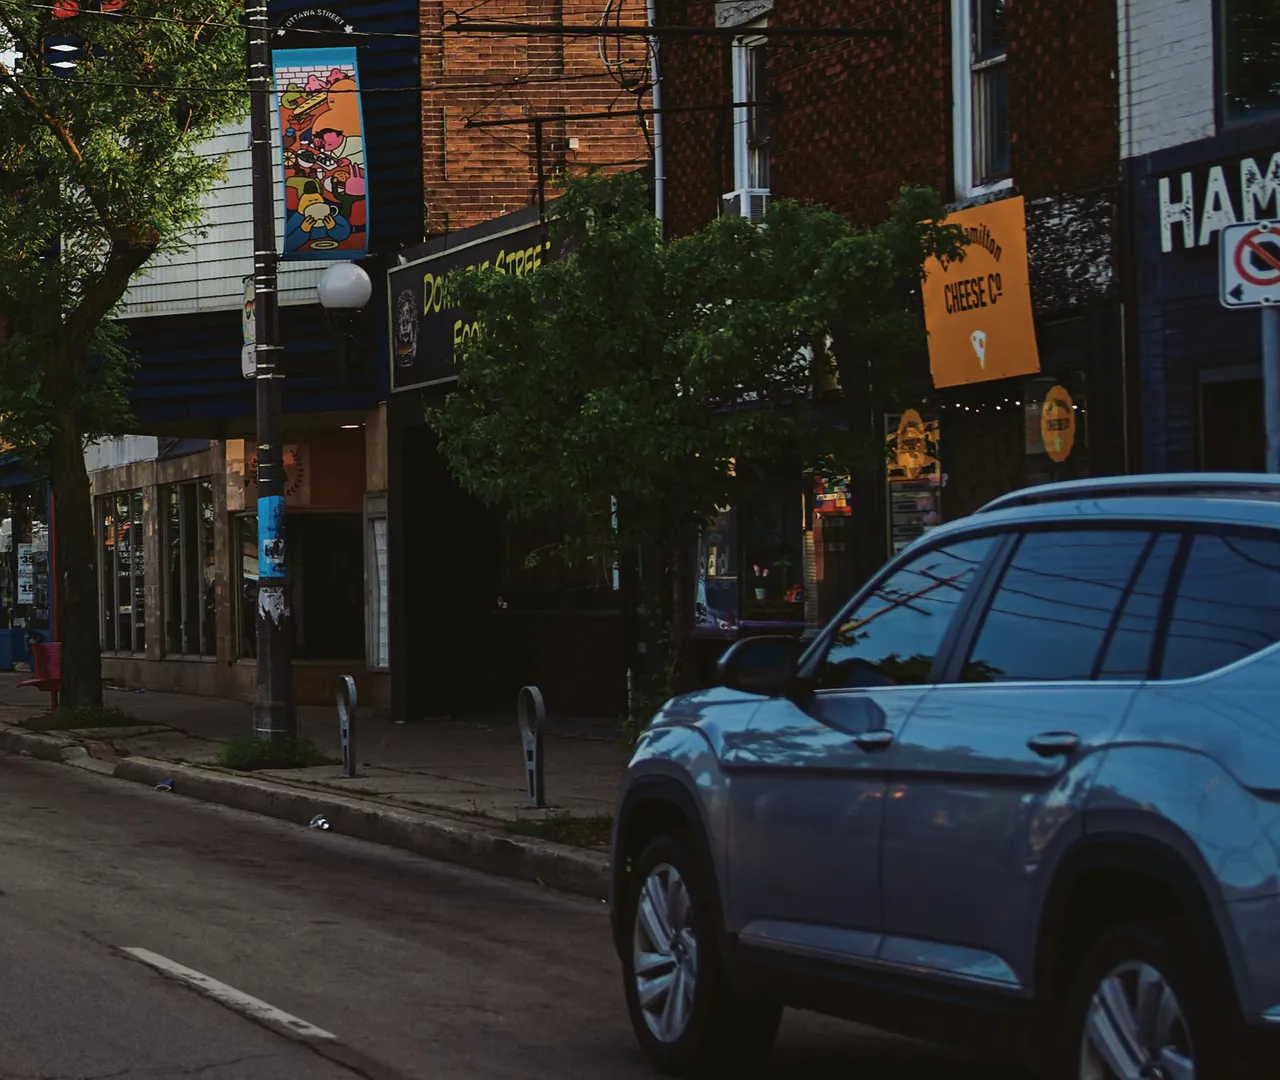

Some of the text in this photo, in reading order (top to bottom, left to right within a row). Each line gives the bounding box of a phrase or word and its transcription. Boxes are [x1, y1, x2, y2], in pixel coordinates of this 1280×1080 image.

[285, 8, 345, 27] OTTAWA STREET
[959, 223, 1002, 263] amilton
[944, 276, 987, 314] CHEESE
